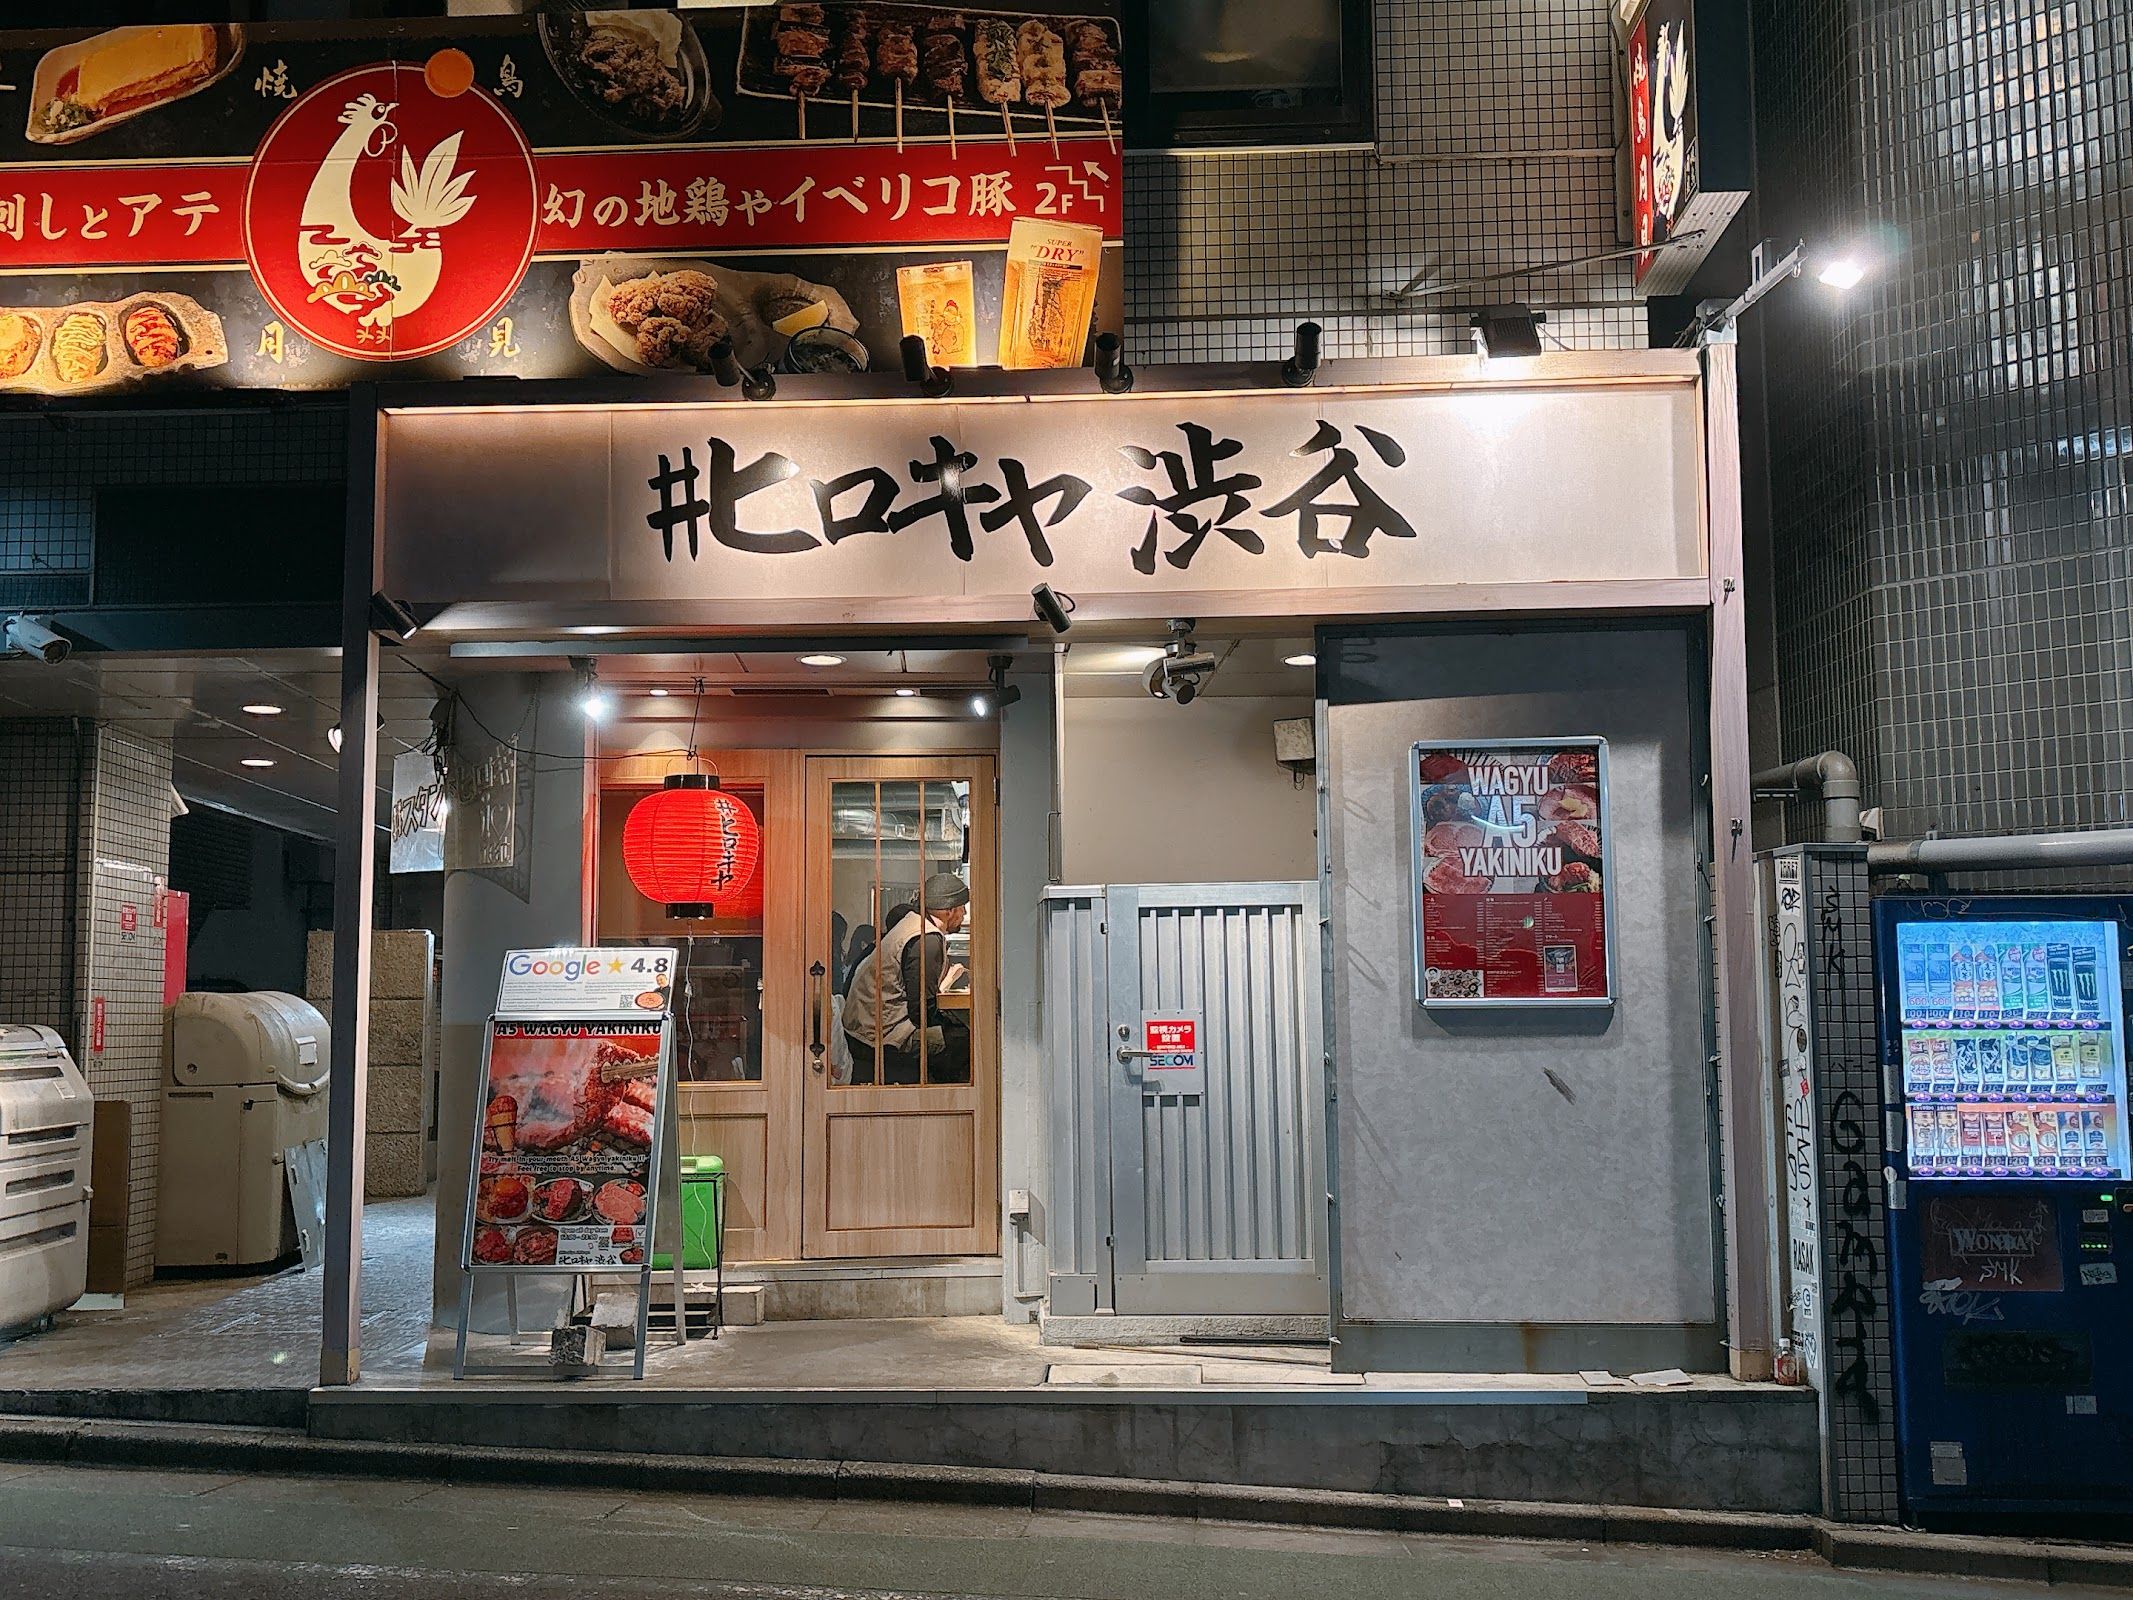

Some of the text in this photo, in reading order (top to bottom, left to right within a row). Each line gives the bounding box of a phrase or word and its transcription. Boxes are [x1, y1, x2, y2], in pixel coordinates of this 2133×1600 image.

[254, 54, 525, 99] 焼 鳥
[542, 169, 1074, 230] 幻の地鶏やイベリコ豚 2F
[1047, 238, 1073, 247] SUPER
[256, 316, 522, 365] 月 見
[1115, 419, 1418, 575] 渋谷
[1467, 764, 1551, 796] WAGYU
[1483, 795, 1538, 848] A5
[1459, 847, 1564, 877] YAKINIKU
[509, 954, 669, 981] Google 4.8
[496, 1022, 661, 1037] A5 WAGYU YAKINIKU
[1149, 1054, 1194, 1066] SECOM
